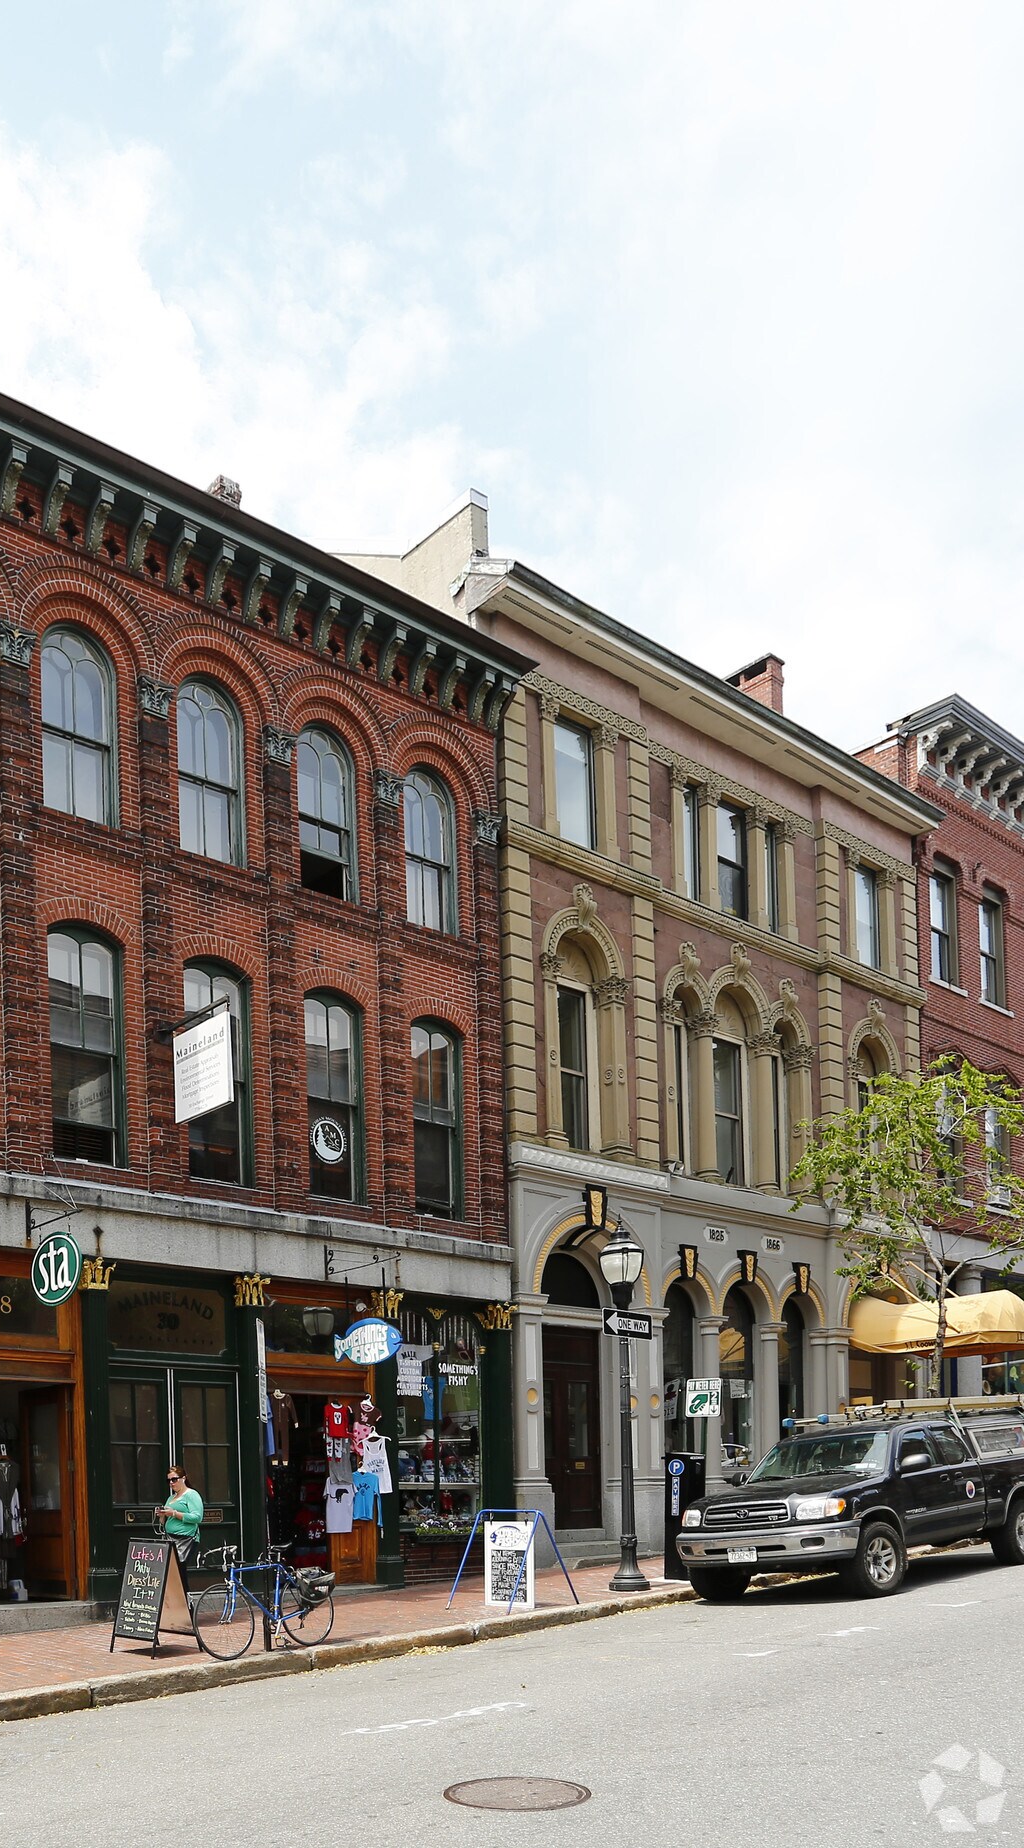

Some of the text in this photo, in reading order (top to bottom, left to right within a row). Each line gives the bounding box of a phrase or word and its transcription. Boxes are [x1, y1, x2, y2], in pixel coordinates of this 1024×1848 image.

[176, 1027, 224, 1059] Maineland
[709, 1228, 725, 1241] 1825
[766, 1238, 781, 1250] 1866
[38, 1240, 72, 1295] sta
[116, 1291, 214, 1320] MAINELAND
[157, 1312, 180, 1330] 30
[618, 1318, 647, 1332] ONE WAY
[351, 1341, 390, 1363] FISHY
[438, 1362, 478, 1376] SOMETHING'S
[448, 1375, 468, 1386] FISHY
[396, 1389, 422, 1397] OUVENIRS
[673, 1462, 680, 1473] P
[157, 1549, 163, 1562] A
